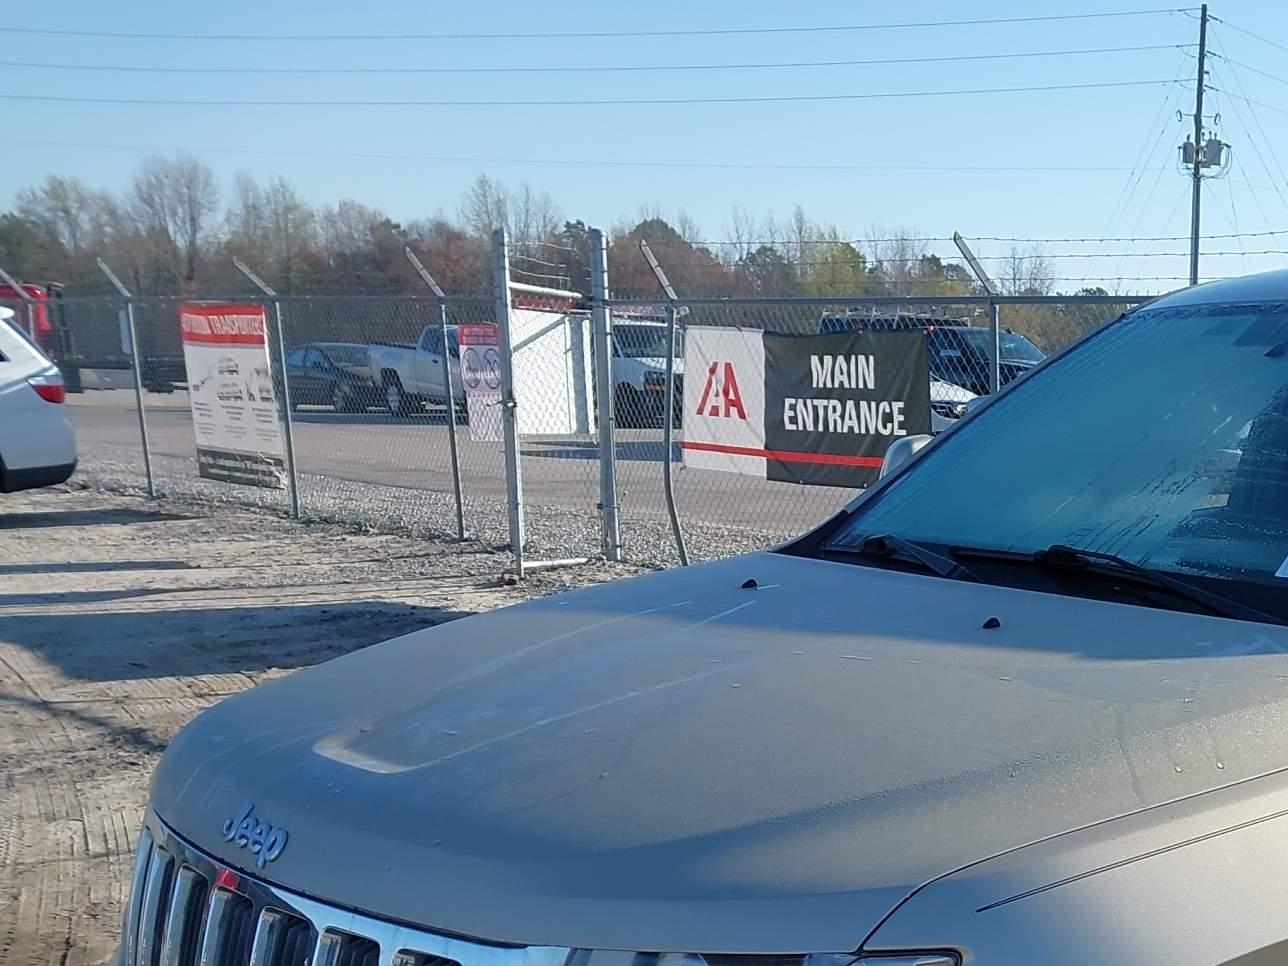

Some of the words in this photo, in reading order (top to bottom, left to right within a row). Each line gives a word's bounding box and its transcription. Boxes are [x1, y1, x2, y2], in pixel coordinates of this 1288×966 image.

[811, 355, 875, 389] MAIN
[783, 398, 907, 436] ENTRANCE
[223, 803, 289, 869] Jeep
